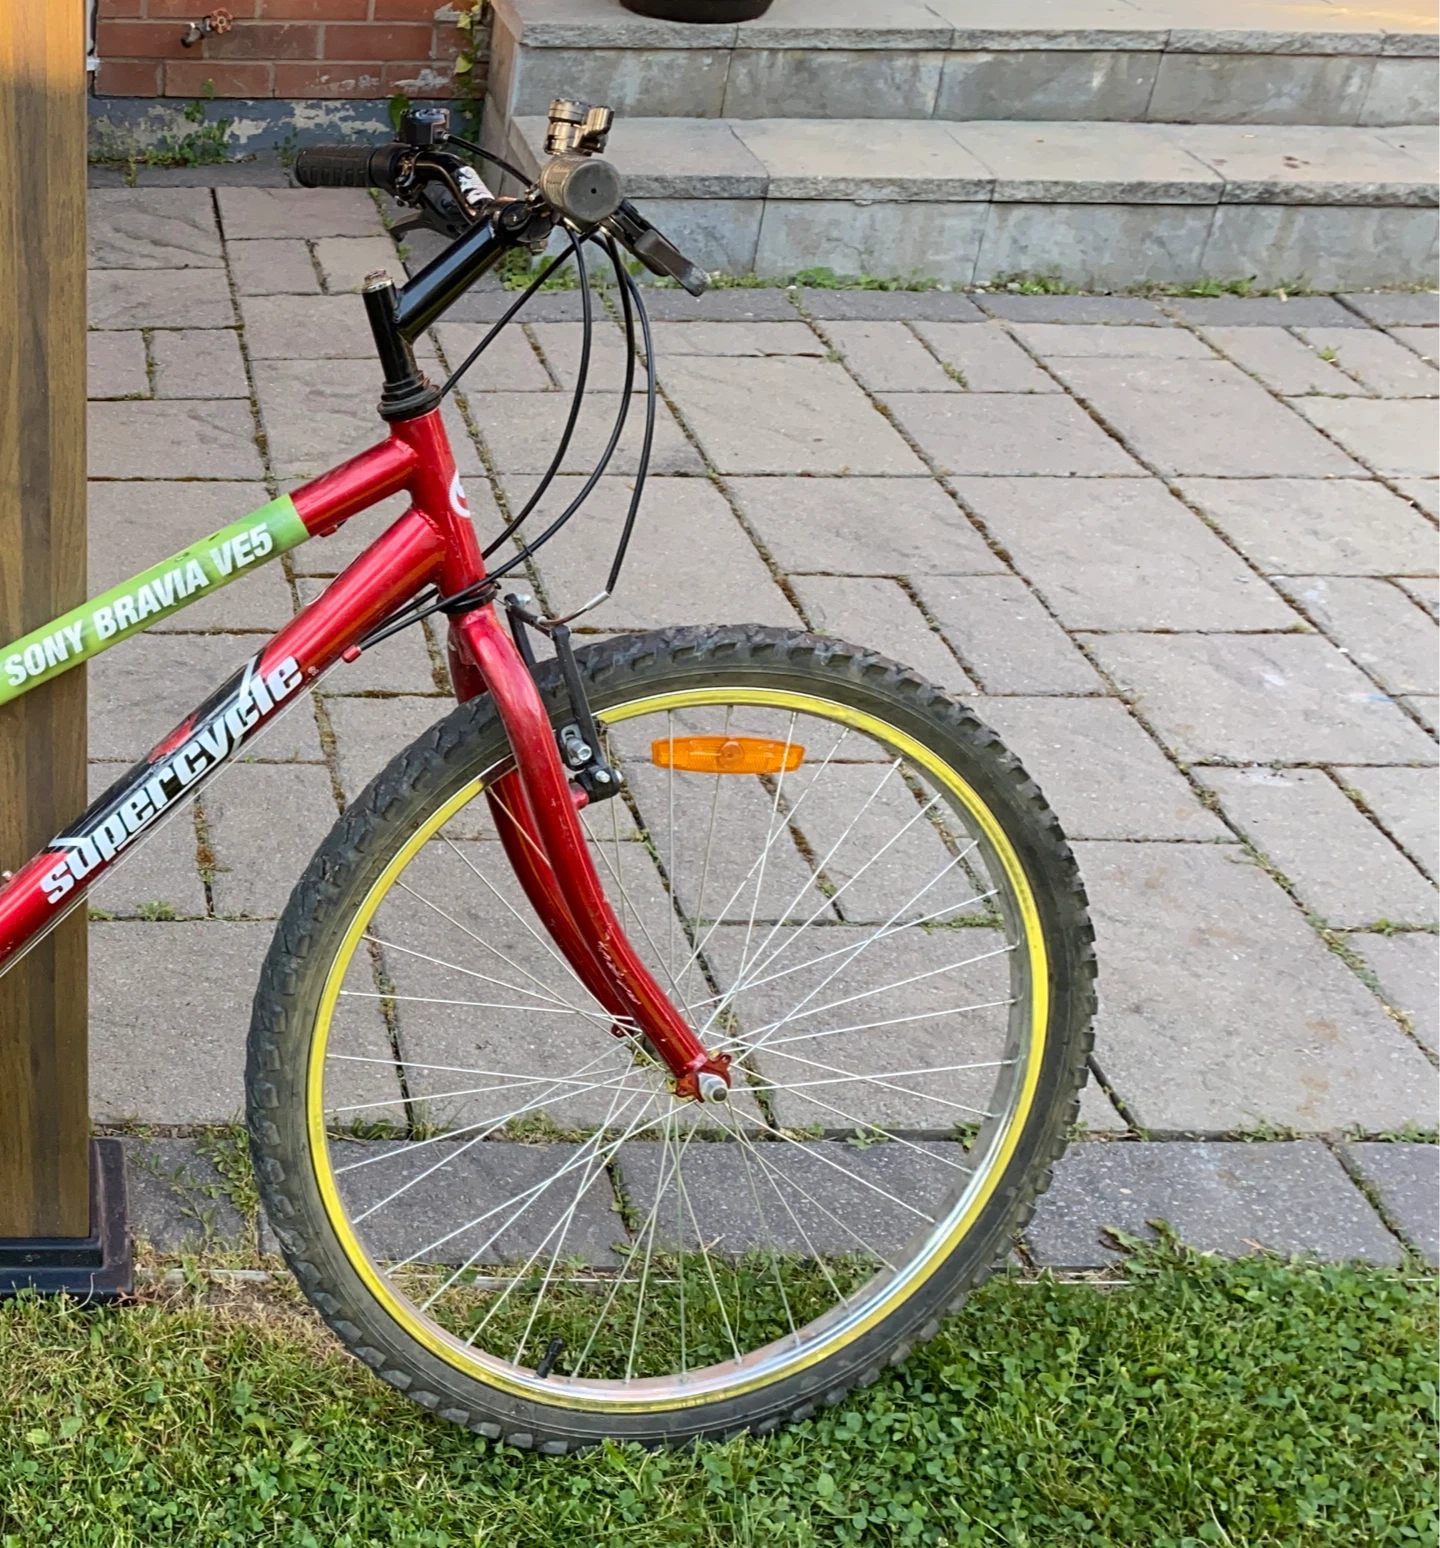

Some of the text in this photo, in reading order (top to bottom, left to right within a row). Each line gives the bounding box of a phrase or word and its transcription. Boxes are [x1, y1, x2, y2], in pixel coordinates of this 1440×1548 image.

[4, 523, 274, 686] SONY BRAVIA VE5
